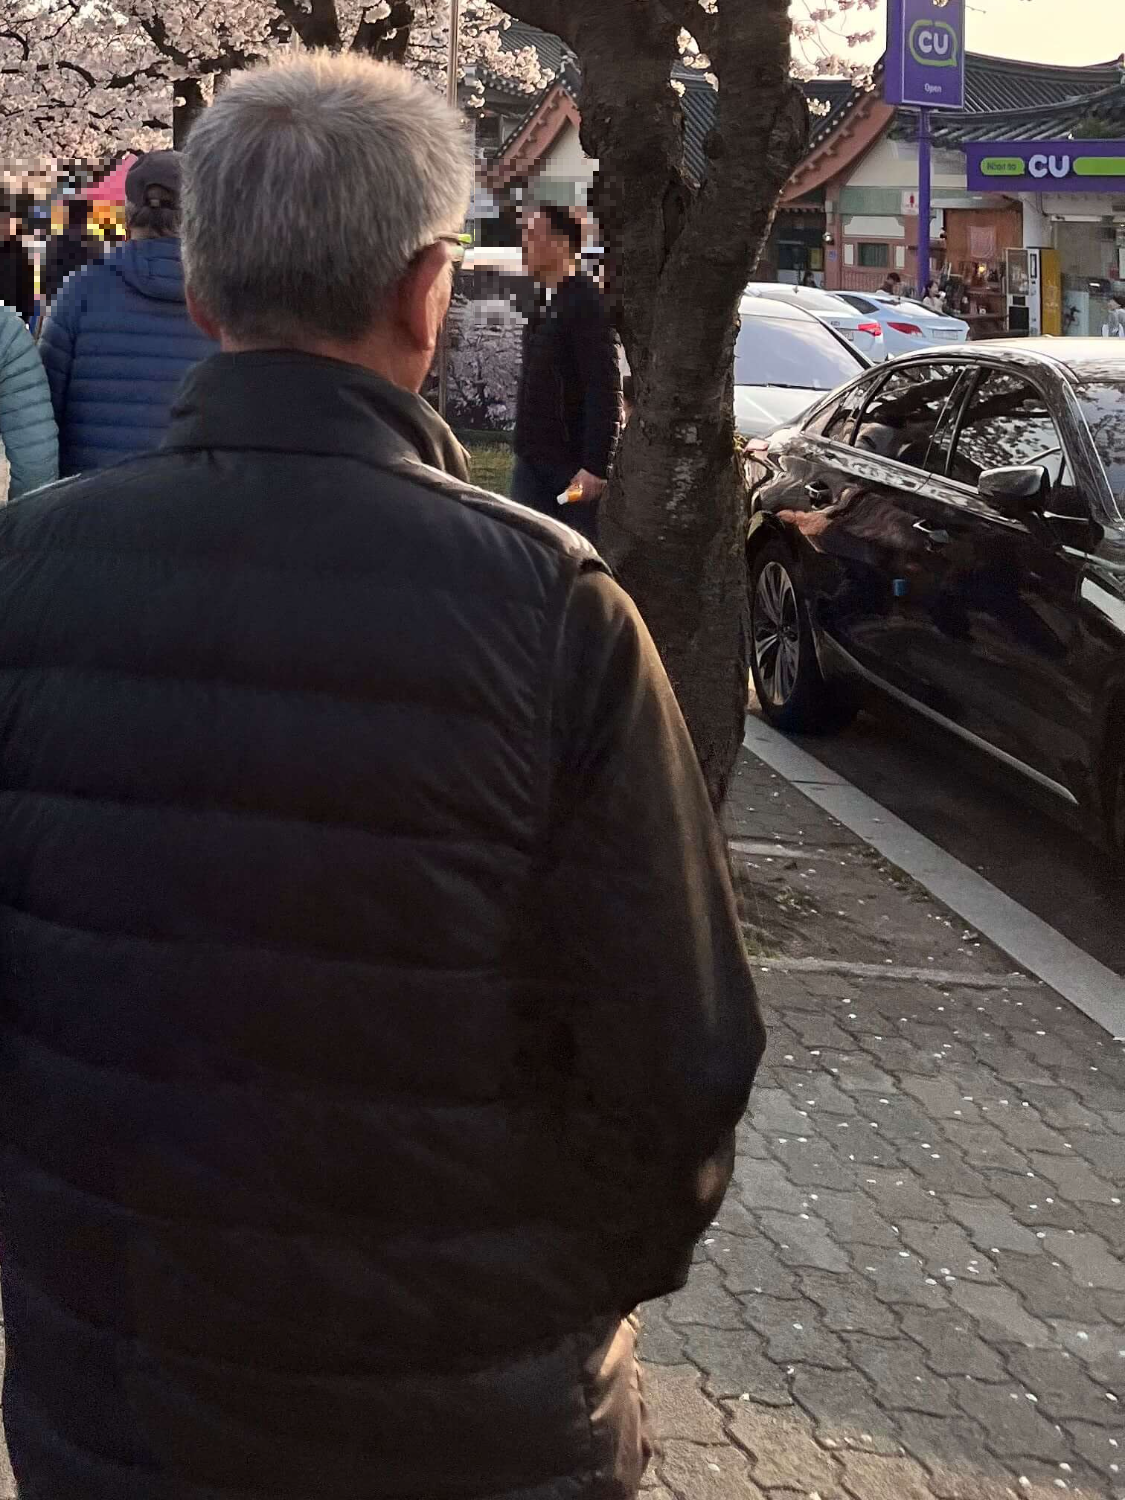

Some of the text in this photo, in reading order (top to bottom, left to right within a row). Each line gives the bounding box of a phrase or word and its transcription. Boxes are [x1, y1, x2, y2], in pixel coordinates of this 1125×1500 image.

[918, 30, 949, 55] CU
[924, 83, 942, 94] Open
[1028, 154, 1070, 178] CU
